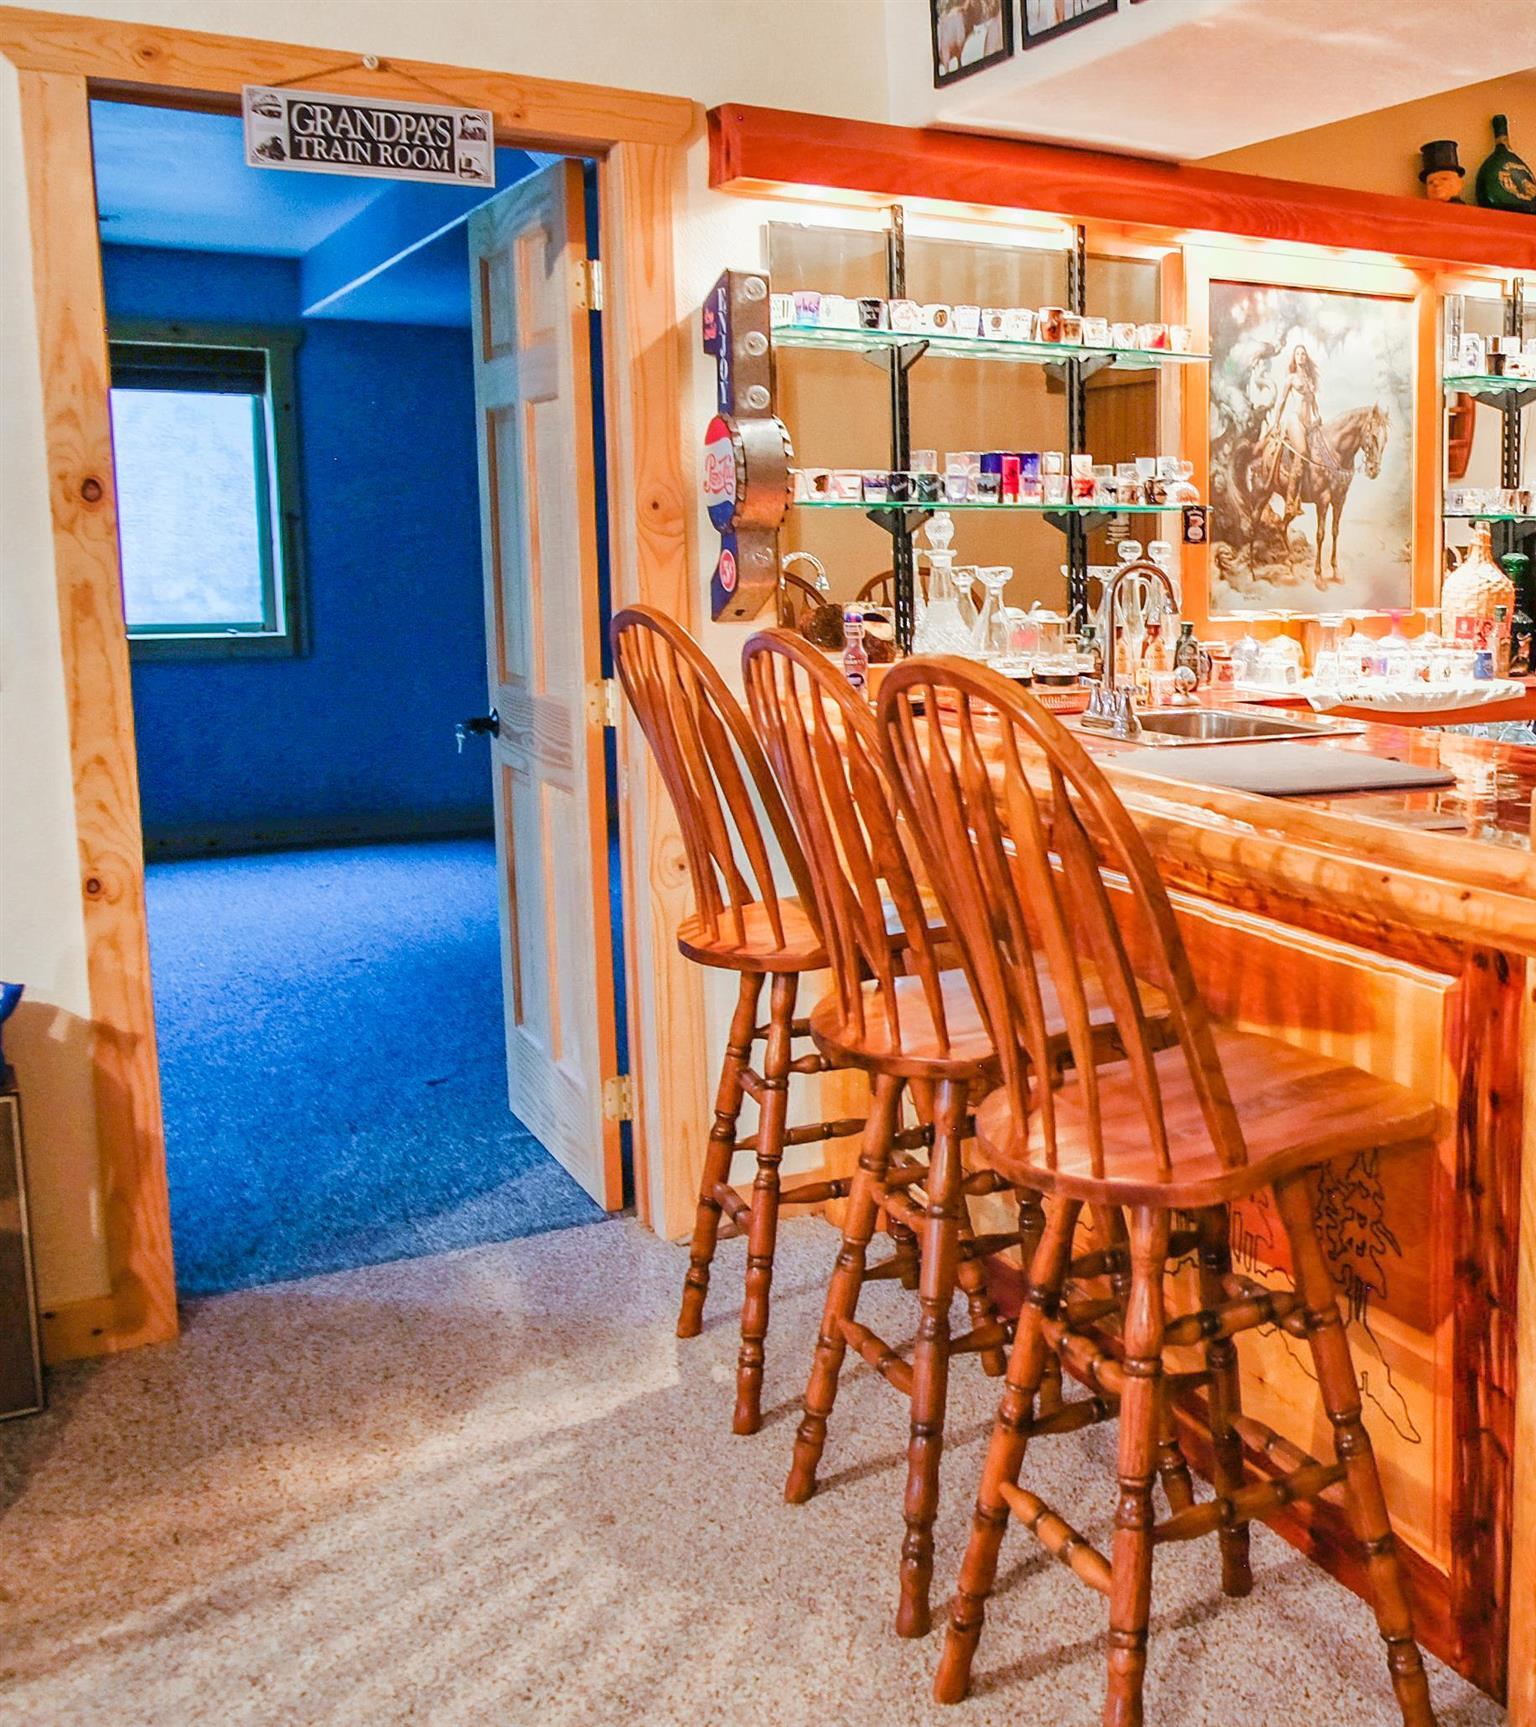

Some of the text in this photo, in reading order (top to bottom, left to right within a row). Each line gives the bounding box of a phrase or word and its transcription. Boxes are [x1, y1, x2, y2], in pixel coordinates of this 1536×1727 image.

[290, 103, 451, 148] GRANDPA'S
[294, 135, 450, 171] TRAIN ROOM
